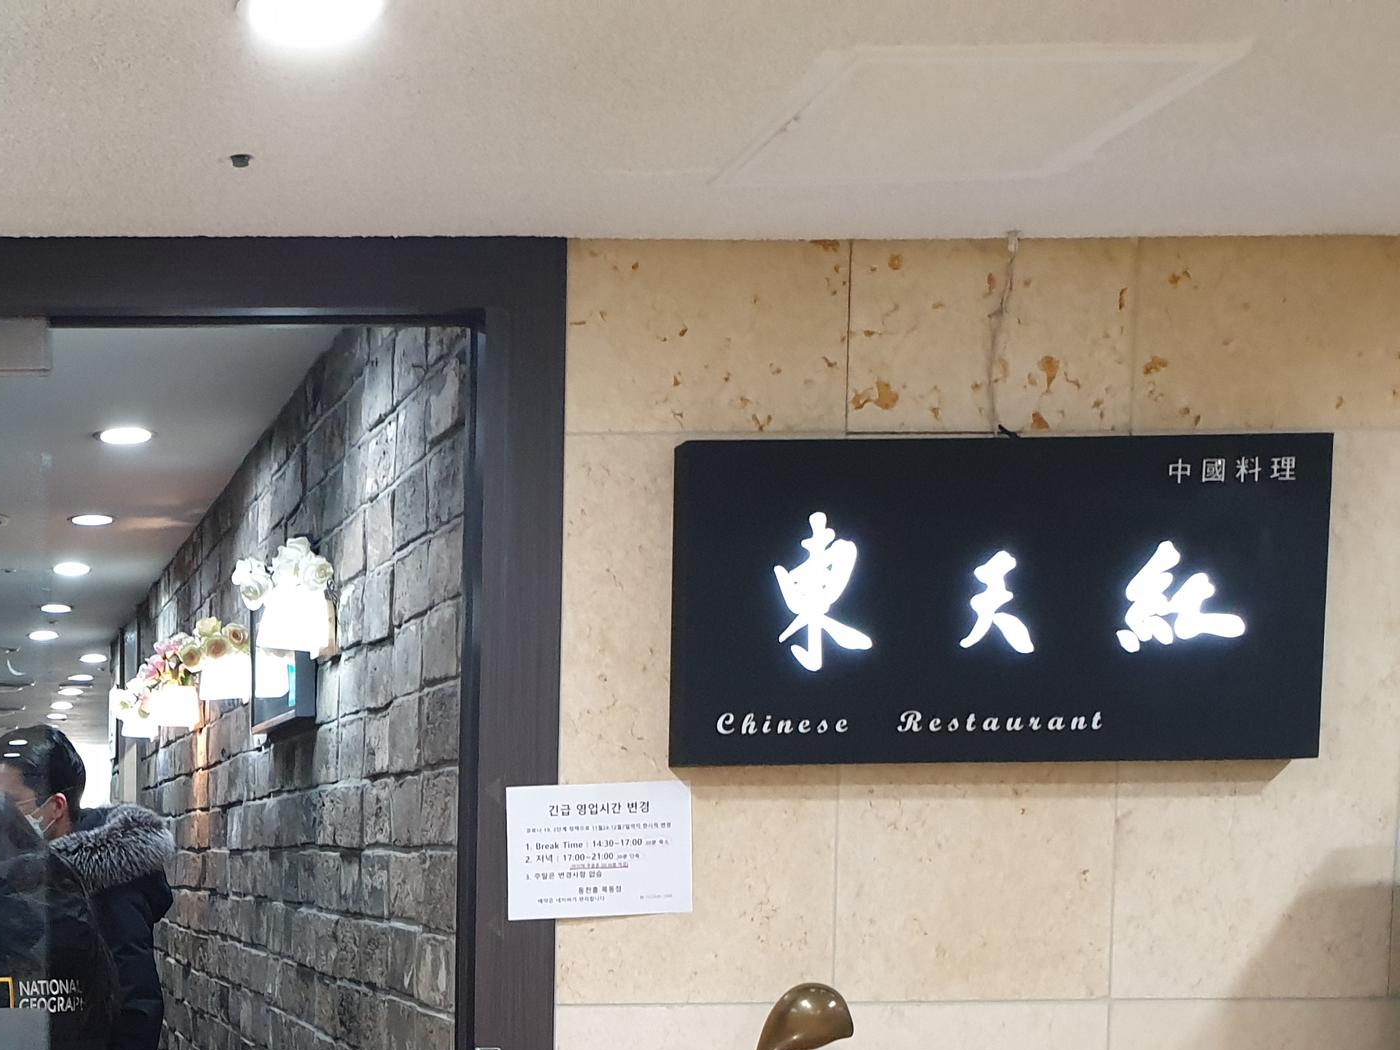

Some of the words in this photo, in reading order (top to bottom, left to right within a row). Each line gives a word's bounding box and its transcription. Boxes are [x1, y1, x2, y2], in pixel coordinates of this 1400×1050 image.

[1167, 455, 1297, 484] 中國料理
[773, 511, 1246, 672] 東天紅
[716, 711, 850, 735] Chinese
[897, 709, 1105, 734] Restaurant
[548, 804, 572, 817] 긴급
[576, 801, 622, 816] 영업시간
[627, 800, 651, 814] 변경
[535, 842, 559, 851] Break
[562, 841, 583, 849] Time
[536, 855, 553, 863] 저녁
[19, 979, 81, 997] NATIONAL
